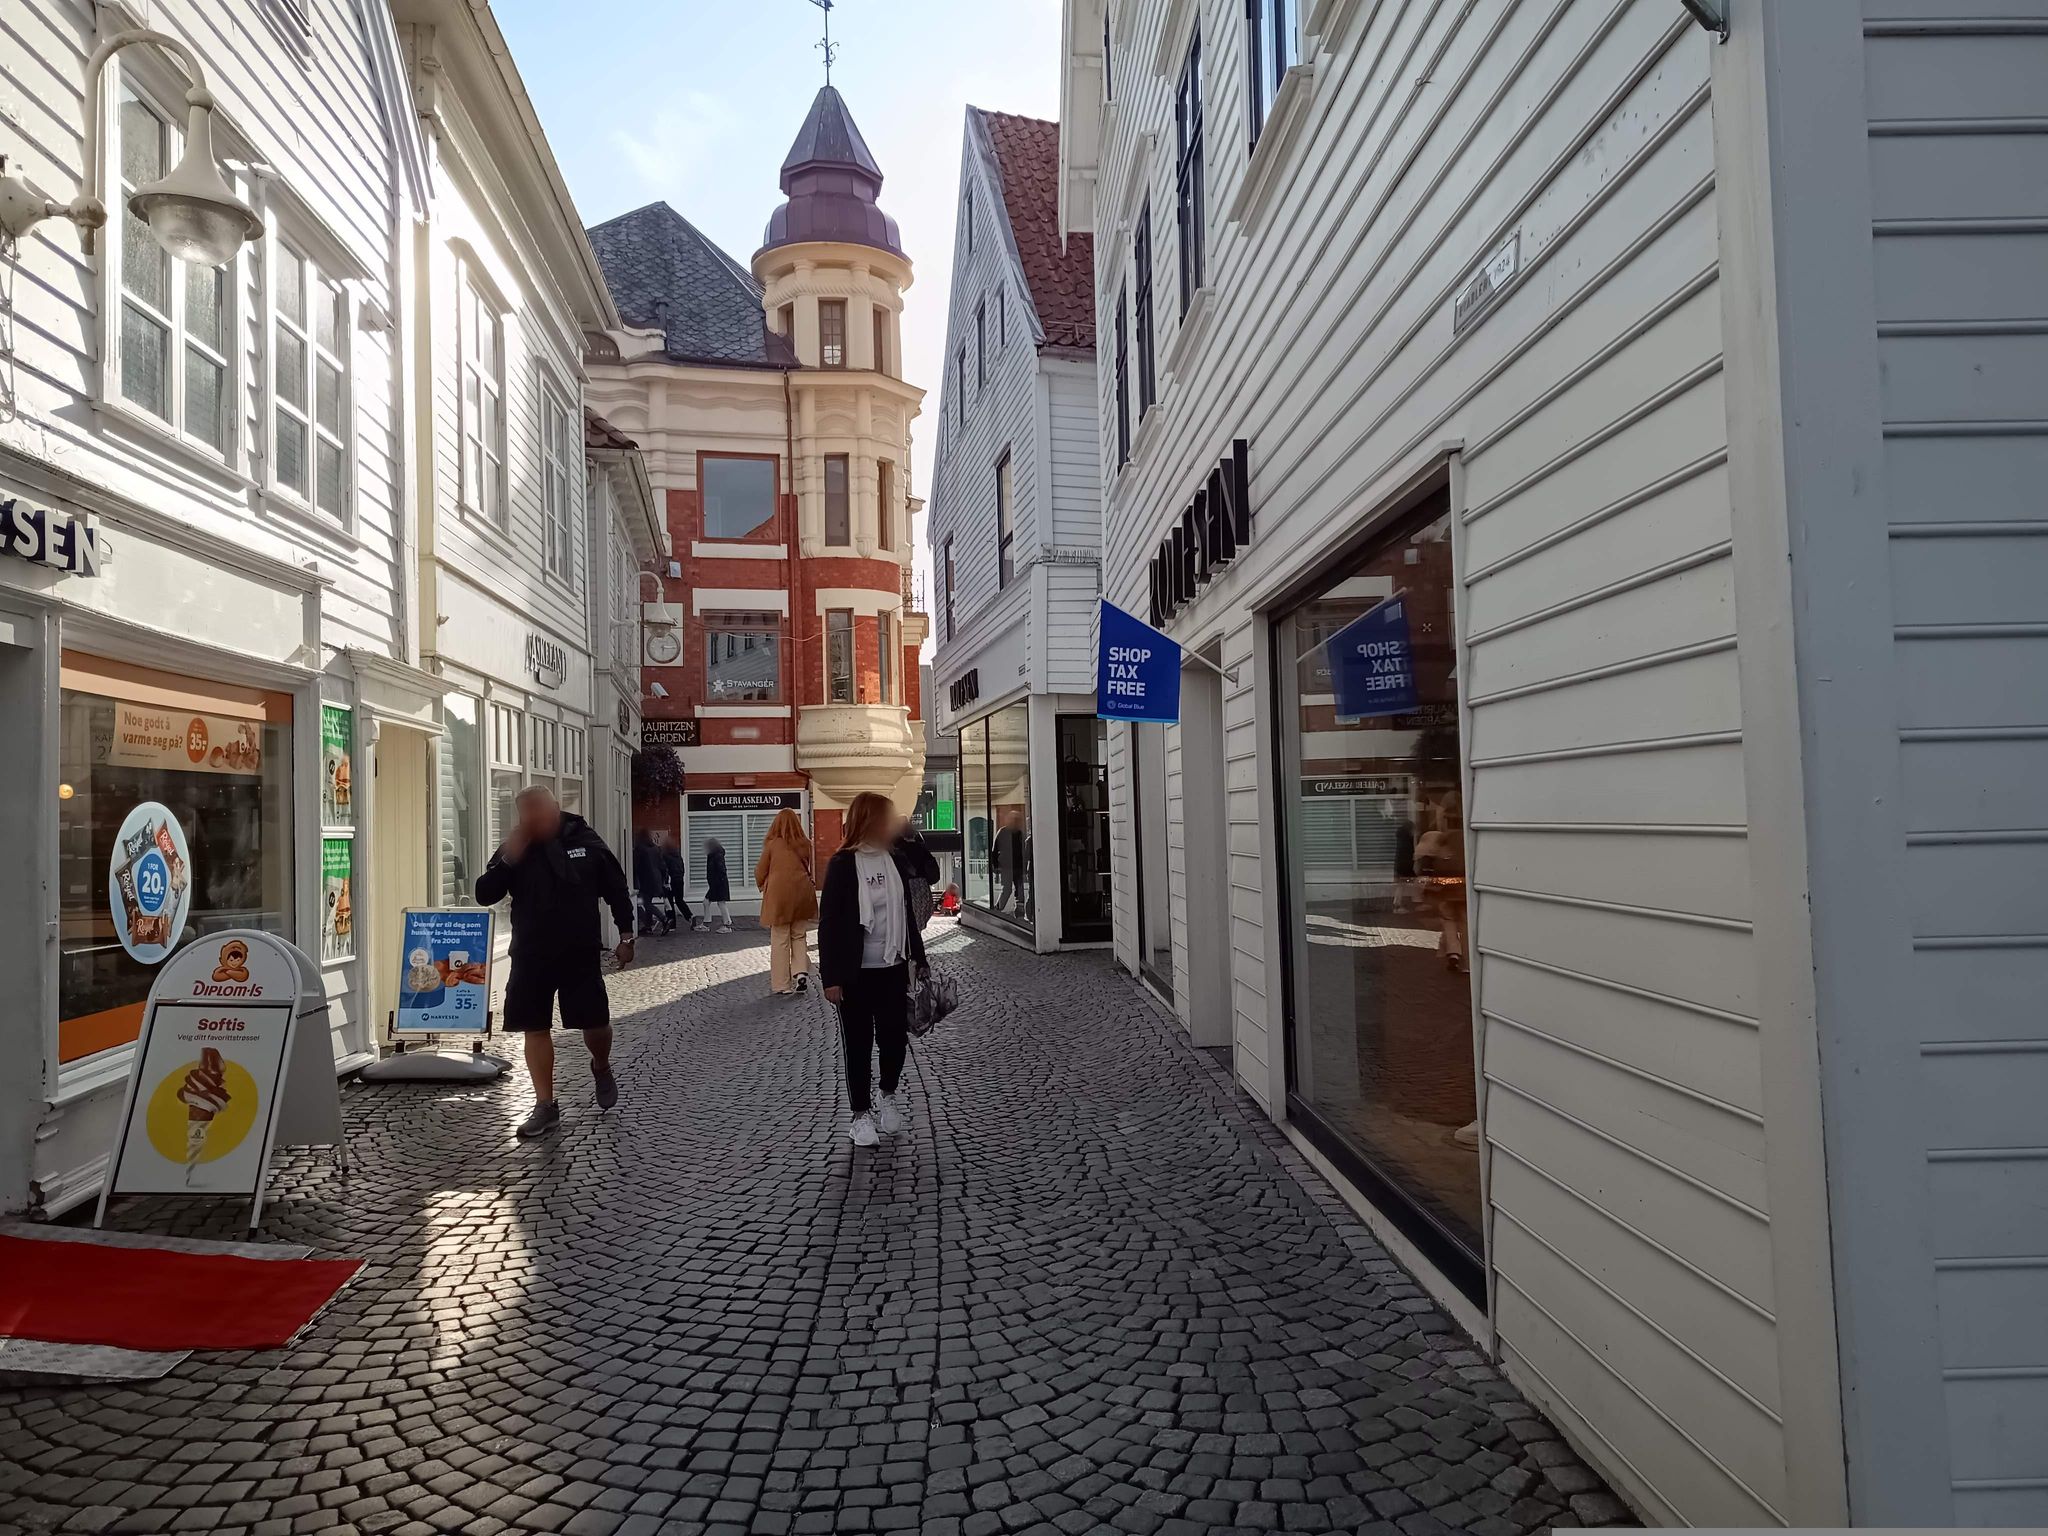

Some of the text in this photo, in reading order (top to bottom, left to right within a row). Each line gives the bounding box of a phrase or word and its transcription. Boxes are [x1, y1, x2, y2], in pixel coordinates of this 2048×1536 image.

[1109, 646, 1151, 663] SHOP
[1107, 663, 1138, 679] TAX
[726, 679, 774, 688] STAVANGER
[1107, 680, 1146, 697] FREE
[124, 711, 171, 731] Noe godt å
[123, 733, 183, 751] varme seg på?
[643, 731, 686, 743] GÅRDEN
[709, 796, 740, 807] GALLERI
[741, 795, 781, 806] ASKELAND
[197, 1018, 245, 1031] Softis
[177, 1033, 193, 1042] Velg
